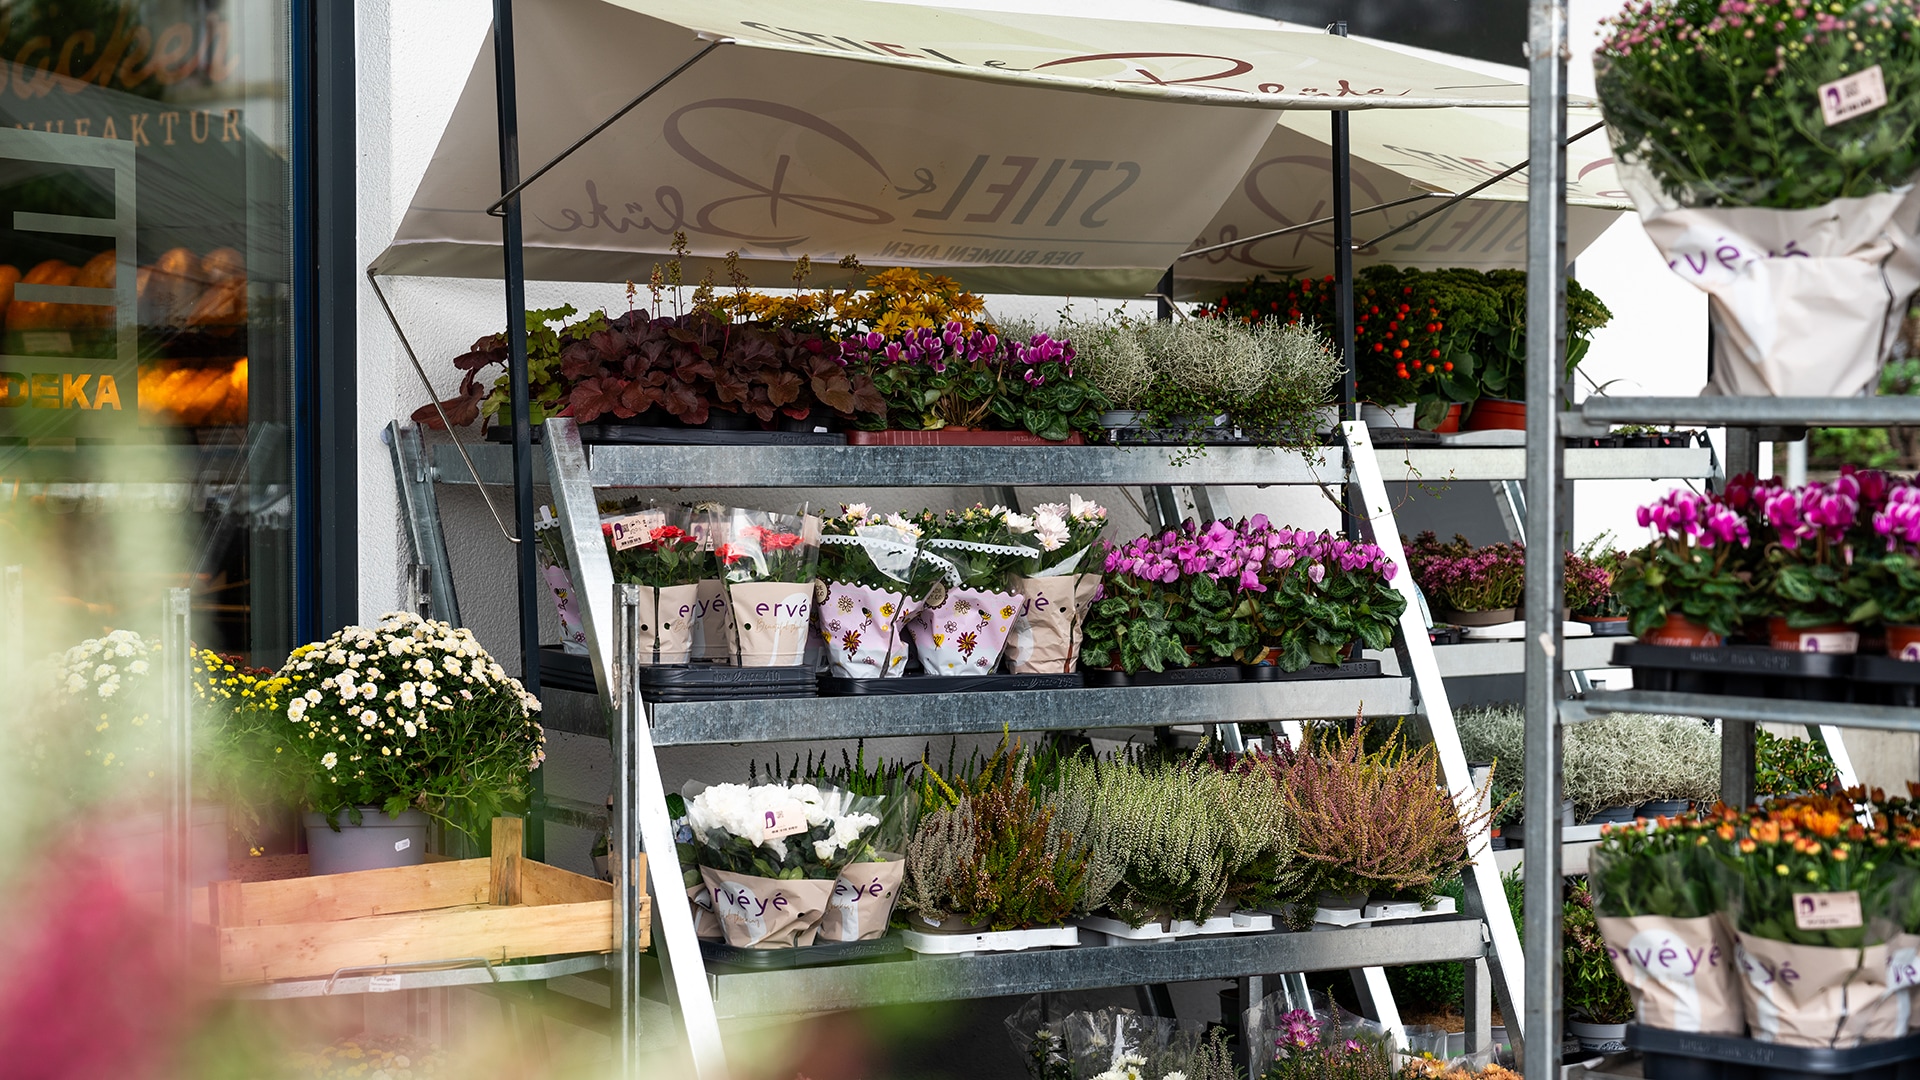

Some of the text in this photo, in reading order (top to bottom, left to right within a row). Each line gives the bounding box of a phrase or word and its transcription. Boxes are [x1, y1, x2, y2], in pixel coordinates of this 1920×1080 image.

[15, 108, 242, 147] FAKTUR
[698, 594, 725, 618] yé
[756, 599, 809, 622] ervé
[1020, 591, 1049, 616] yé
[835, 877, 883, 902] éyé
[714, 888, 788, 917] rvéyé
